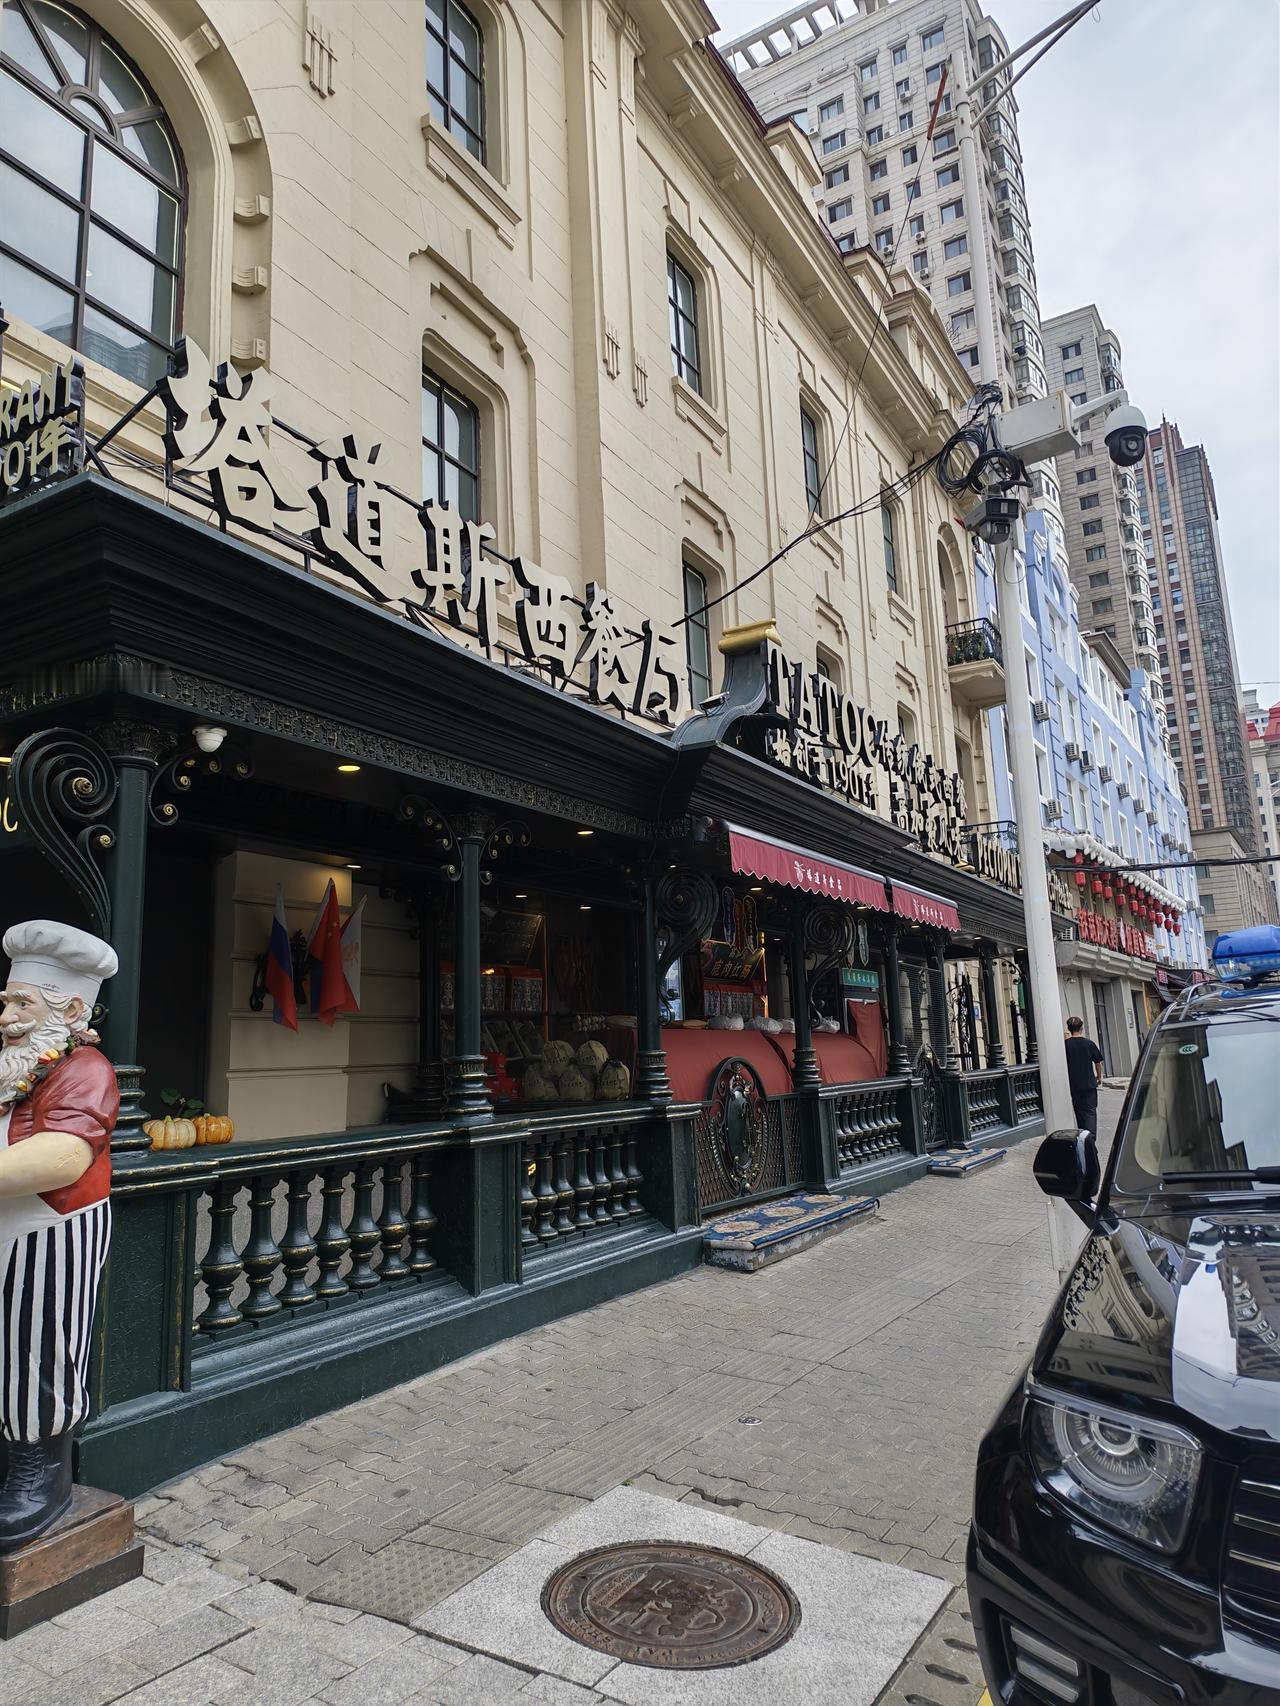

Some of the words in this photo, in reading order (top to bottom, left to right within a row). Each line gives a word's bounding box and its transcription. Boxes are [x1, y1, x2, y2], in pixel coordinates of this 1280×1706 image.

[160, 335, 689, 724] 塔道斯西餐厅
